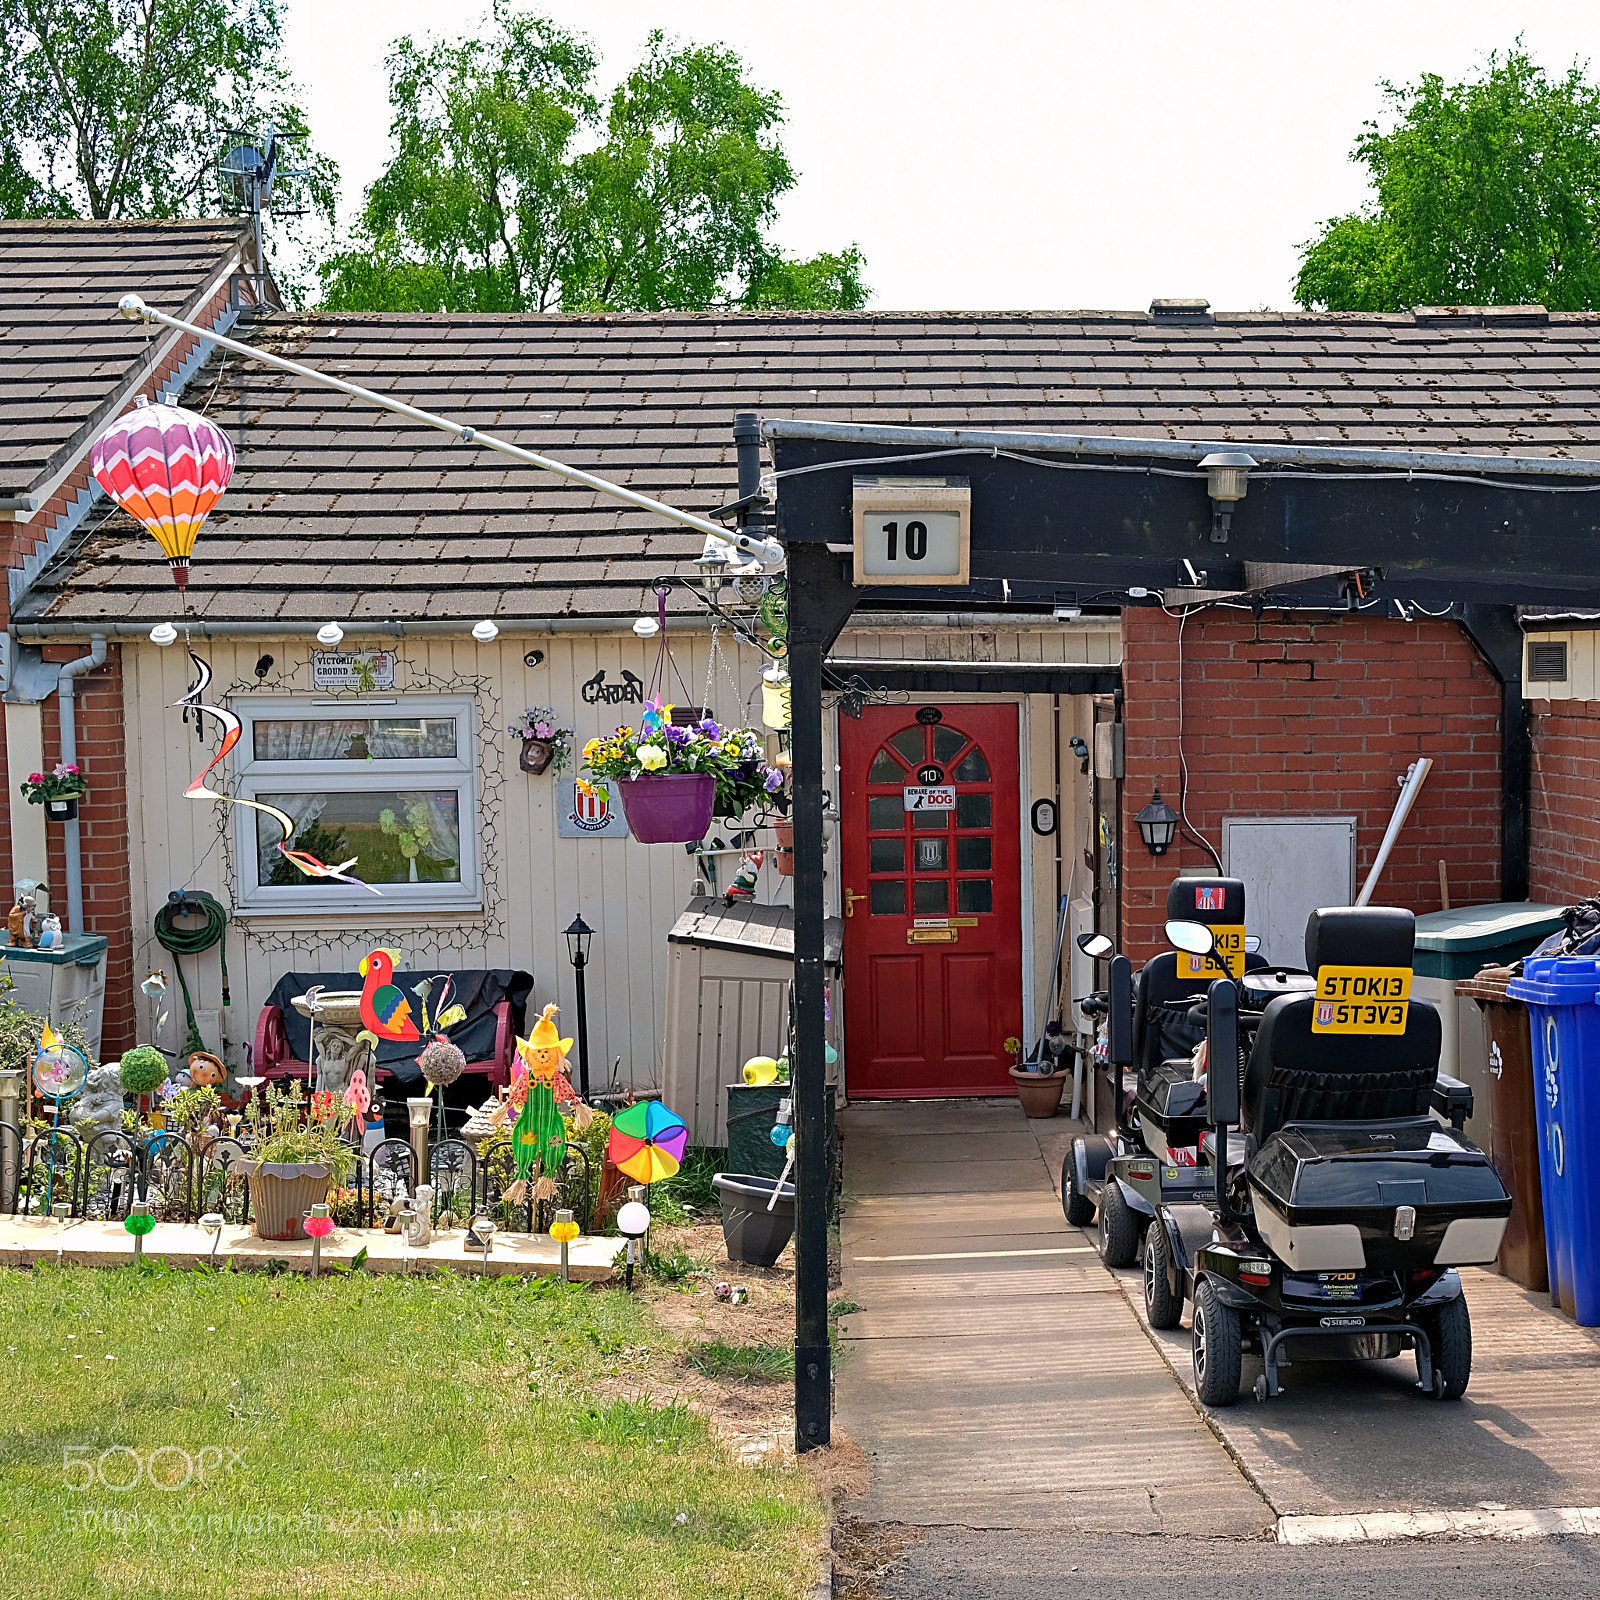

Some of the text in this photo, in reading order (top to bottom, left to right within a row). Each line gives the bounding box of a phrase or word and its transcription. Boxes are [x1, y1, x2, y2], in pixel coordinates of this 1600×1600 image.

[882, 520, 928, 561] 10
[317, 667, 348, 676] GROUND
[582, 682, 644, 705] GARDEN
[922, 769, 937, 782] 10
[927, 794, 953, 804] DOG
[1336, 1005, 1404, 1025] ST3V3
[1317, 1272, 1356, 1281] S700
